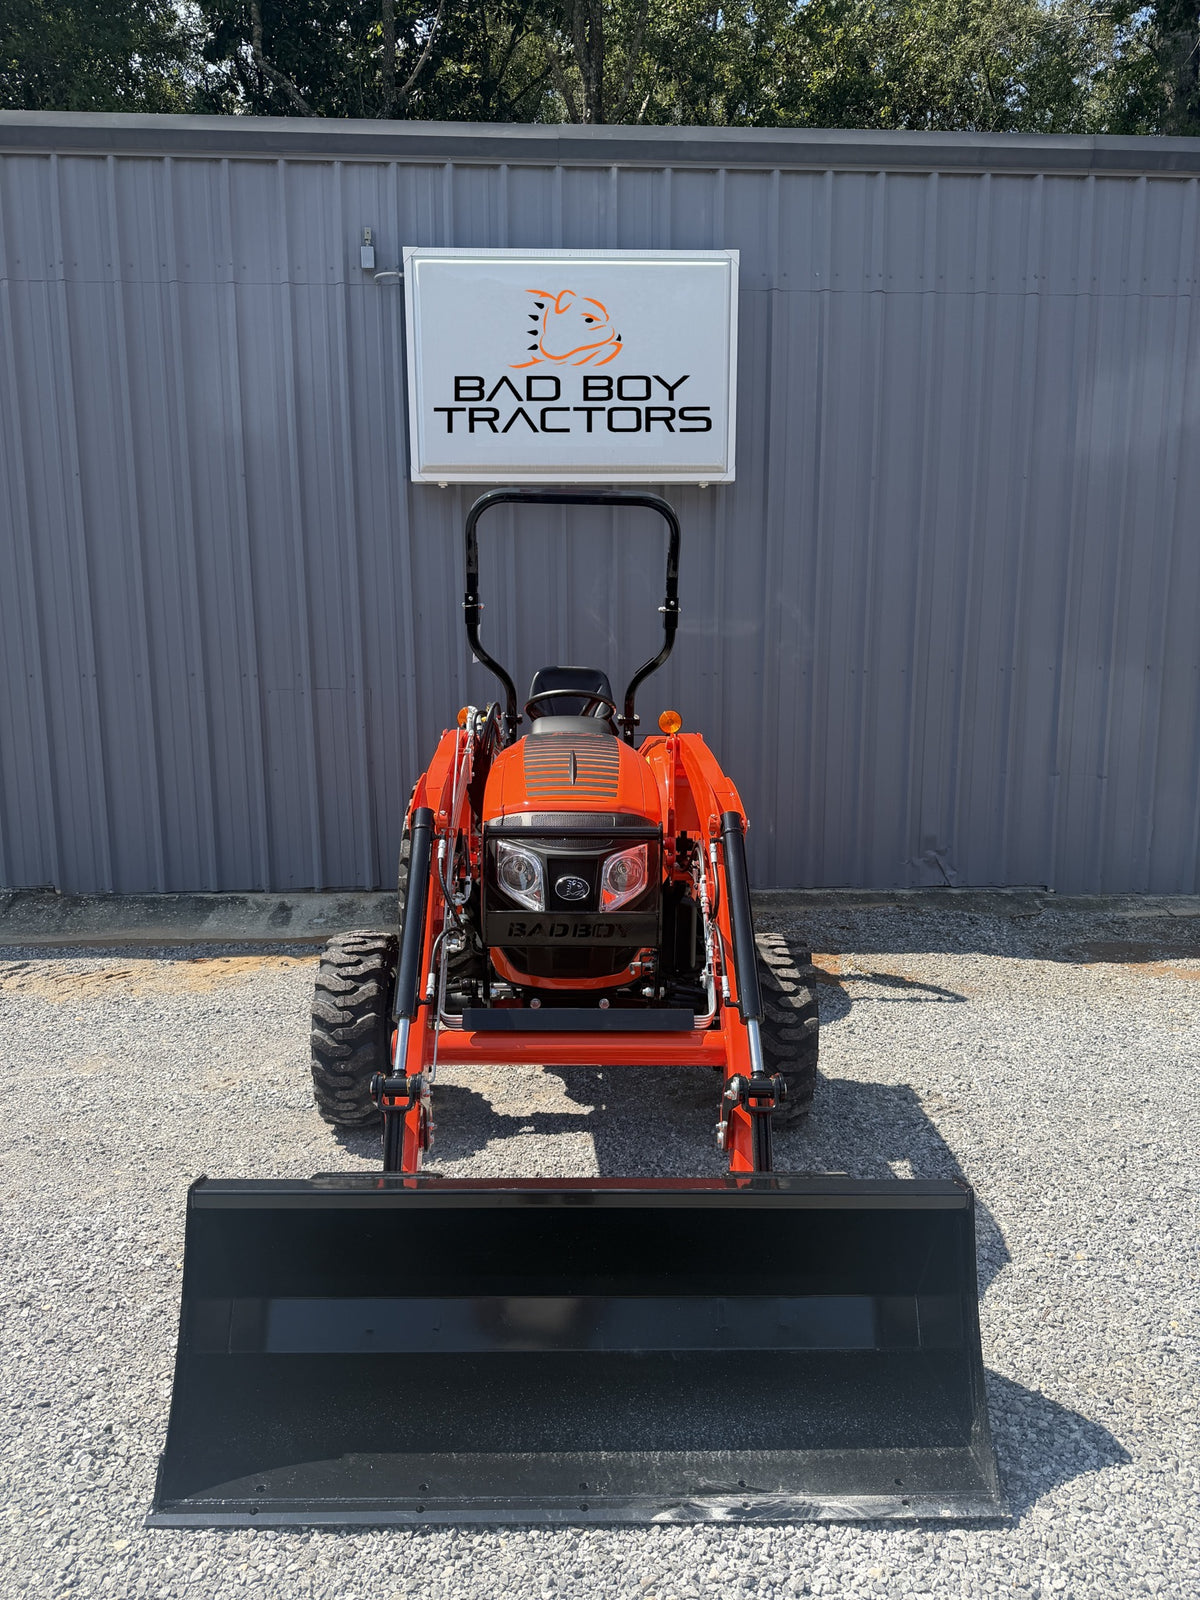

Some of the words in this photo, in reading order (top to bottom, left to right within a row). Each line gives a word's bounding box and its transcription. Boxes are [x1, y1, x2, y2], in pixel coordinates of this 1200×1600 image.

[454, 375, 561, 402] BAD
[583, 375, 690, 402] BOY
[434, 406, 712, 433] TRACTORS
